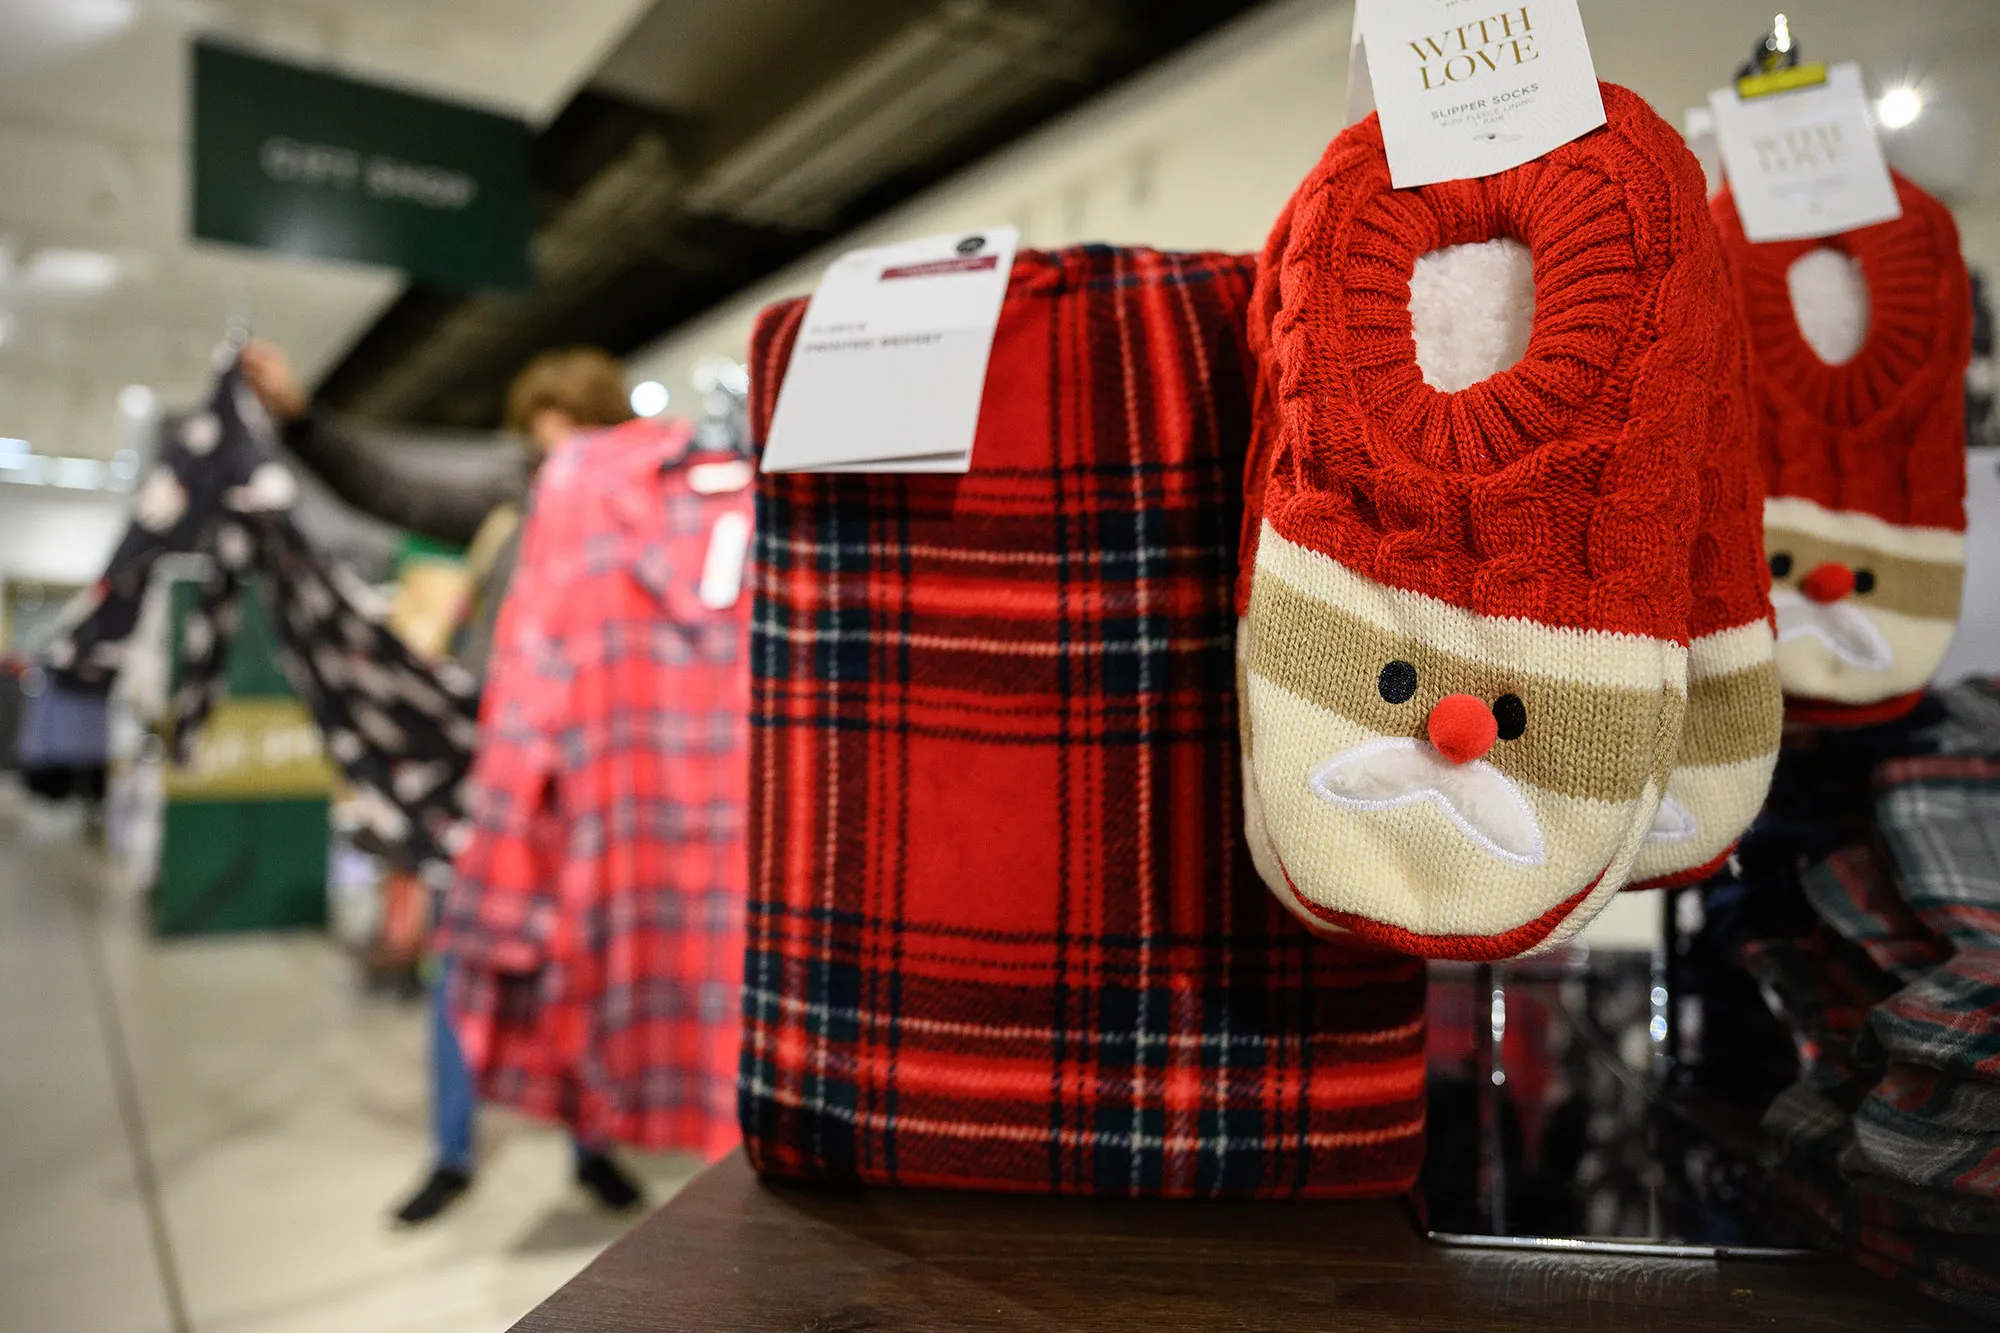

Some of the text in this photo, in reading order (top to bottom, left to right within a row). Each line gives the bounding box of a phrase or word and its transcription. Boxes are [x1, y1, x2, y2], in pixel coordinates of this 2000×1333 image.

[1406, 7, 1535, 63] WITH
[1418, 35, 1540, 90] LOVE
[1431, 83, 1539, 120] SLIPPER SOCKS
